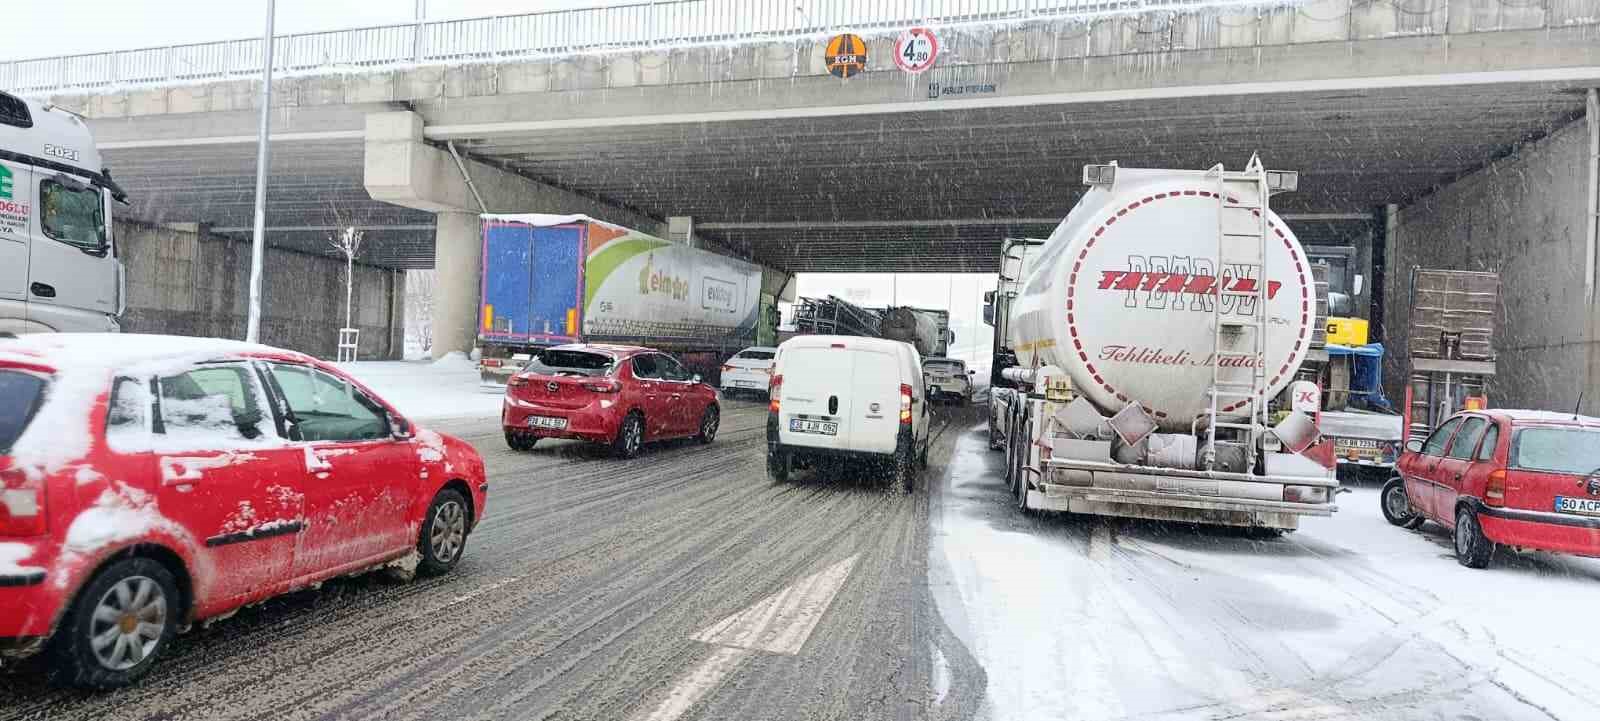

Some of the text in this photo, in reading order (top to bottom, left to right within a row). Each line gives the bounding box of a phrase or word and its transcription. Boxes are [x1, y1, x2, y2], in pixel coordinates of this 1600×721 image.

[834, 55, 857, 64] KGM
[904, 40, 915, 61] 4
[43, 143, 80, 161] 2021
[1099, 345, 1190, 367] Tehlikeli
[1562, 499, 1577, 510] 60
